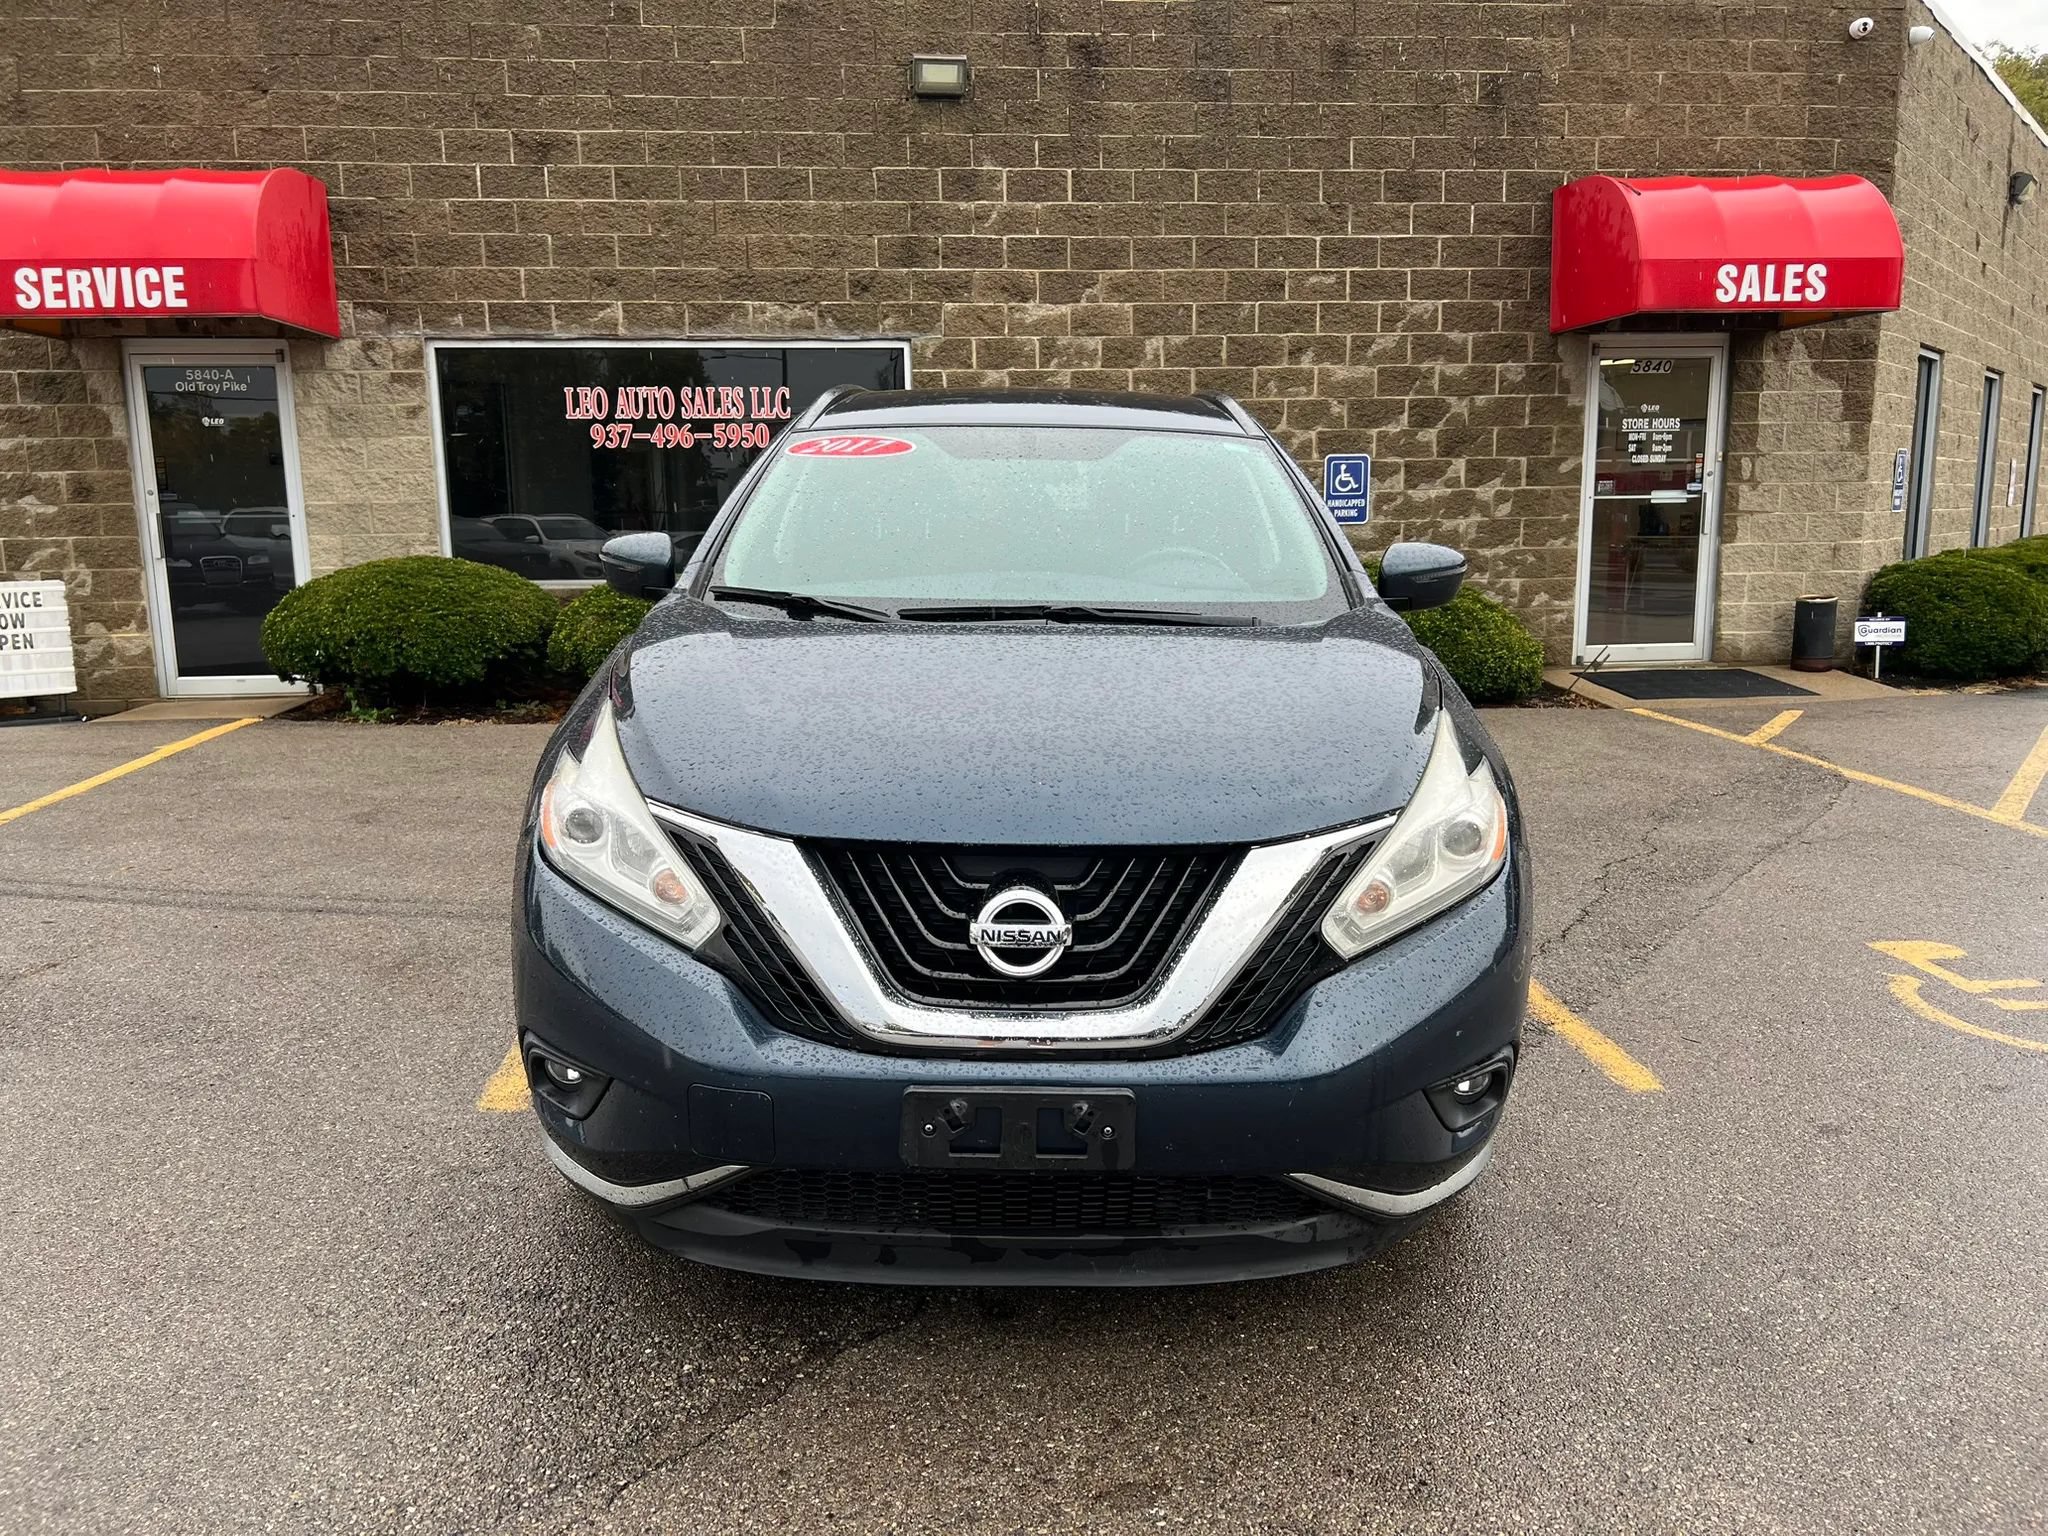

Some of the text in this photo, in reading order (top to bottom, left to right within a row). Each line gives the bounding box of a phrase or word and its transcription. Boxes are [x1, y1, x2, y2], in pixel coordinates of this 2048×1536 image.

[14, 266, 188, 310] SERVICE
[1716, 263, 1828, 303] SALES
[1632, 360, 1672, 373] 5840
[185, 369, 235, 381] 5840-A
[175, 381, 248, 394] Old Troy Pike
[563, 386, 792, 420] LEO AUTO SALES LLC
[1647, 404, 1660, 412] LEO
[210, 417, 225, 426] LEO
[1621, 417, 1681, 430] STORE HOURS
[589, 423, 771, 449] 937-496-5950
[799, 439, 896, 453] 2017
[1627, 443, 1637, 453] SAT
[1631, 454, 1667, 463] CLOSED SUNDAY
[1327, 499, 1366, 507] HANDICAPPED
[1334, 508, 1358, 518] PARKING
[0, 591, 43, 609] VICE
[1860, 626, 1902, 634] Guardian
[980, 929, 1062, 943] NISSAN
